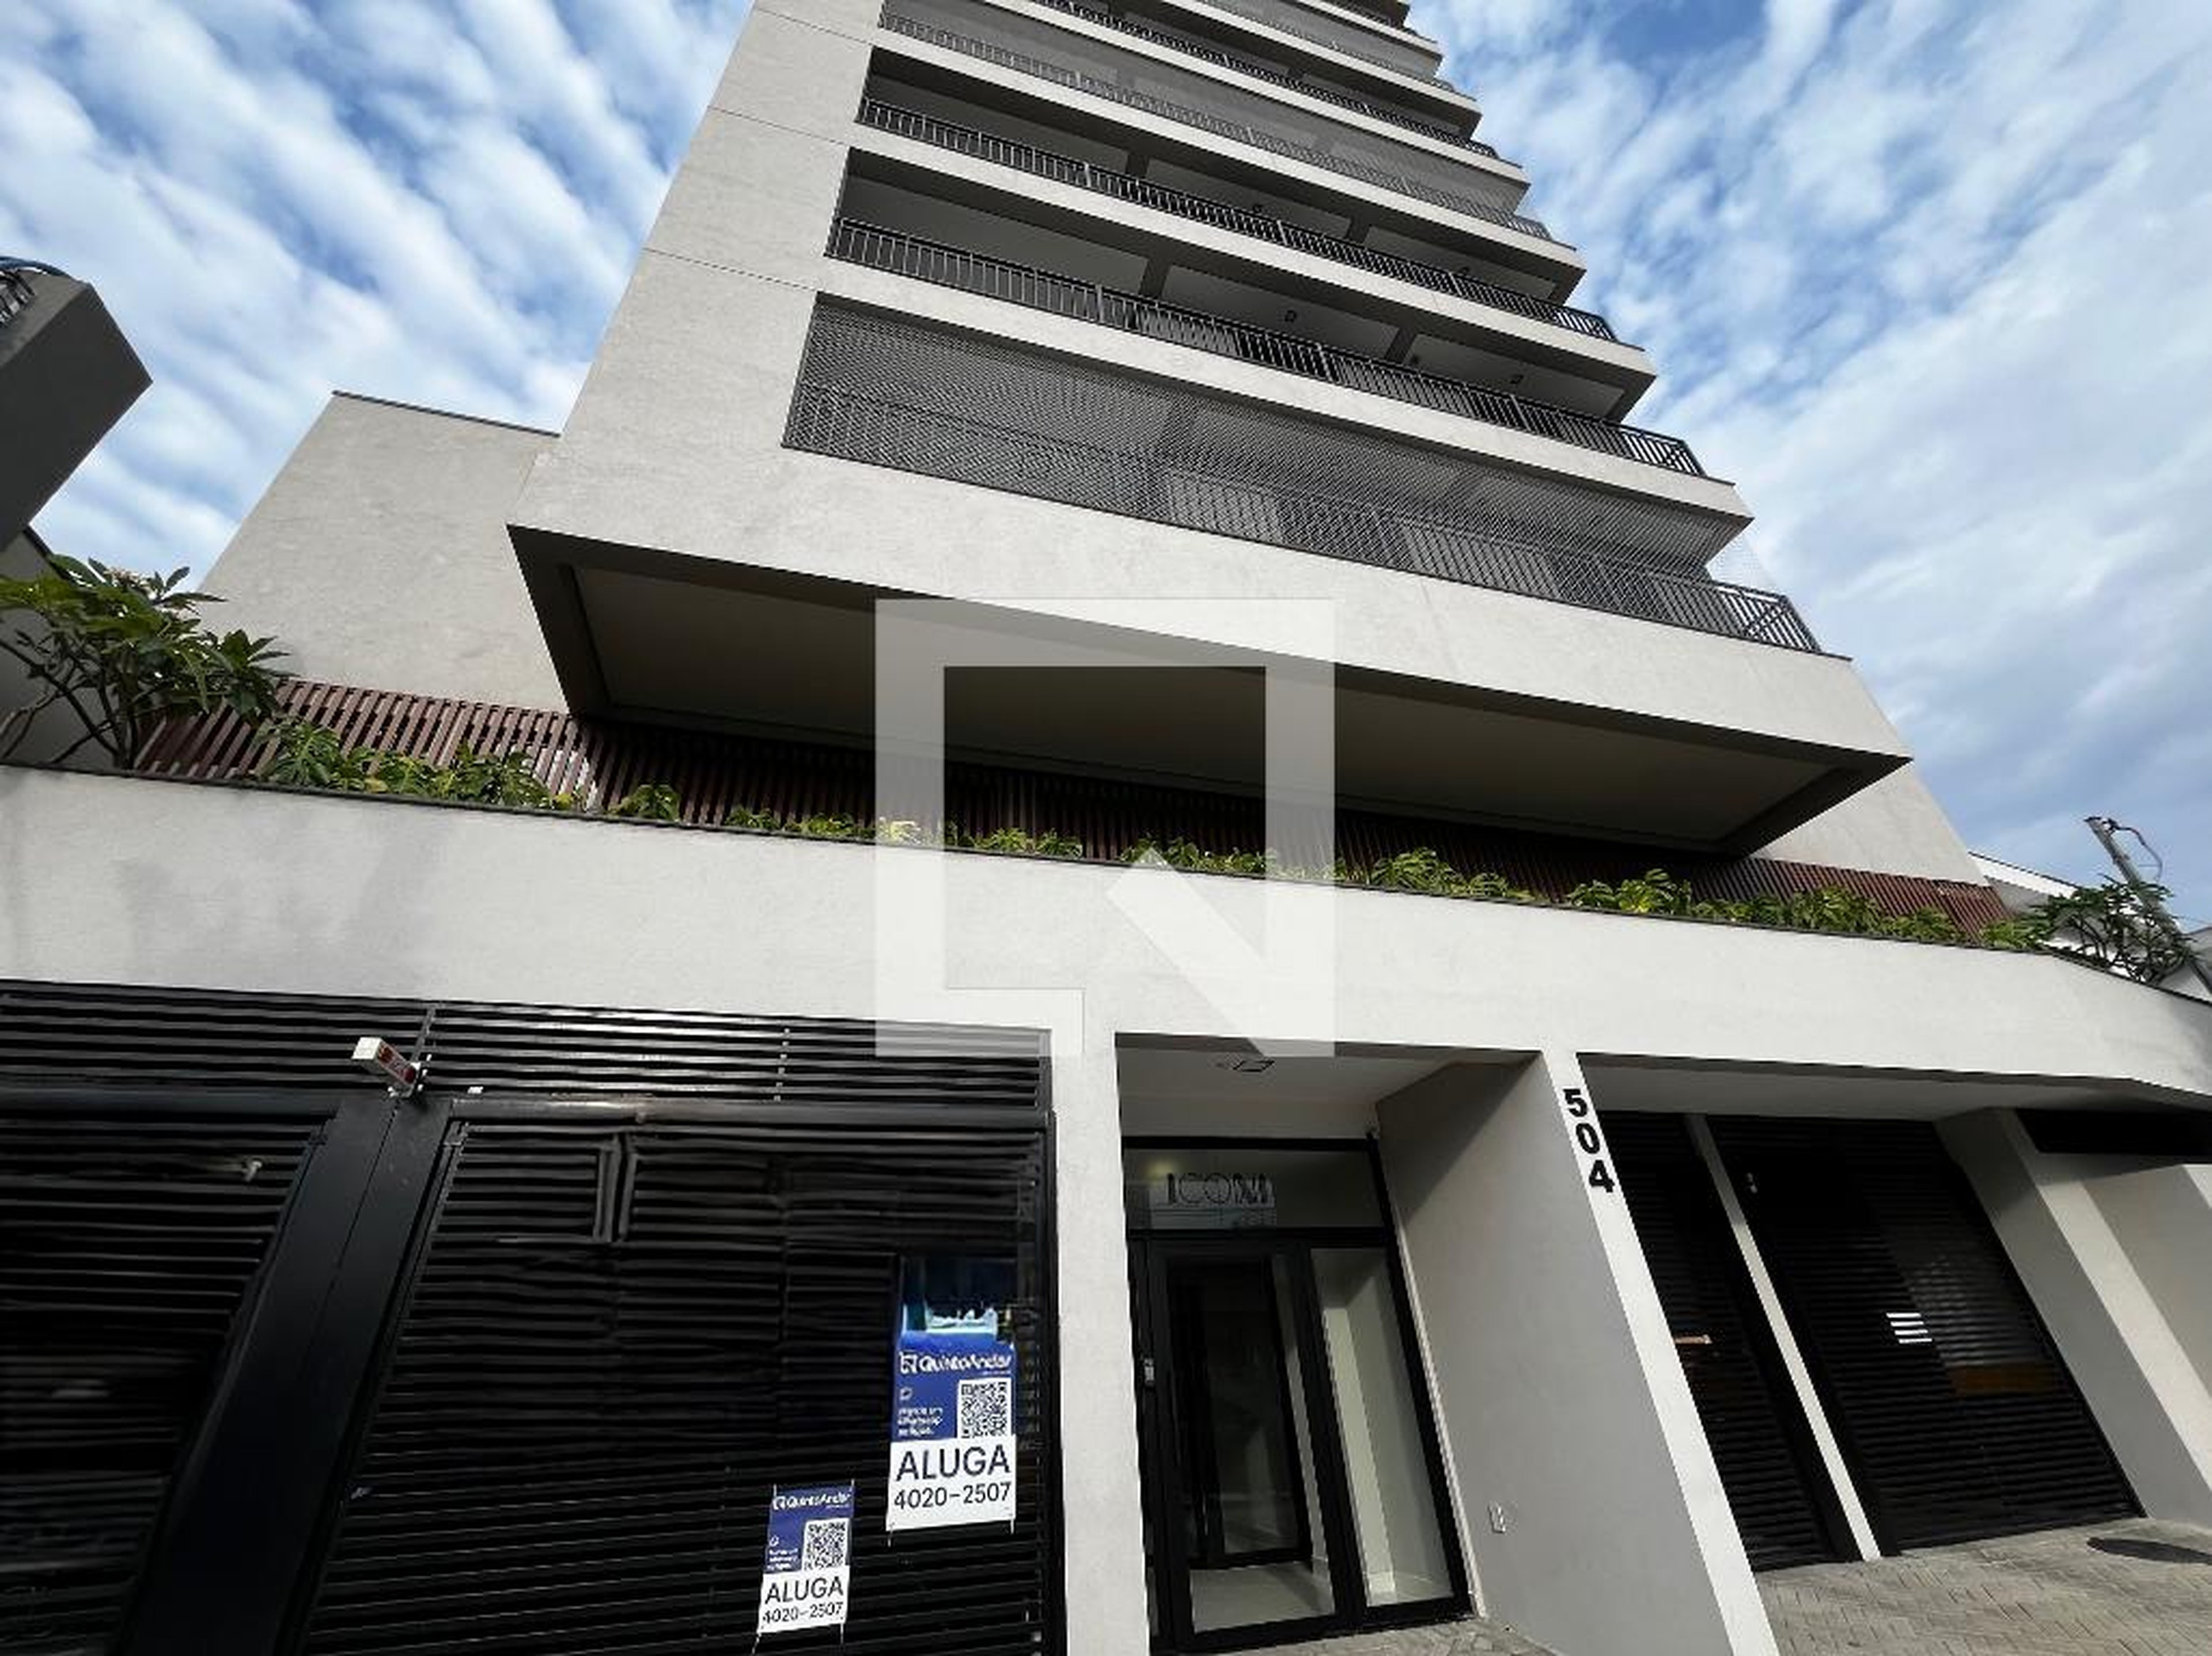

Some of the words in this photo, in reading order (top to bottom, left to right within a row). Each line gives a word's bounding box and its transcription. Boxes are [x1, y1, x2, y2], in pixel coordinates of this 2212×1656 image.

[1562, 1088, 1615, 1193] 504
[896, 1445, 1010, 1481] ALUGA
[894, 1482, 1012, 1510] 4020-2507
[764, 1576, 844, 1604] ALUGA
